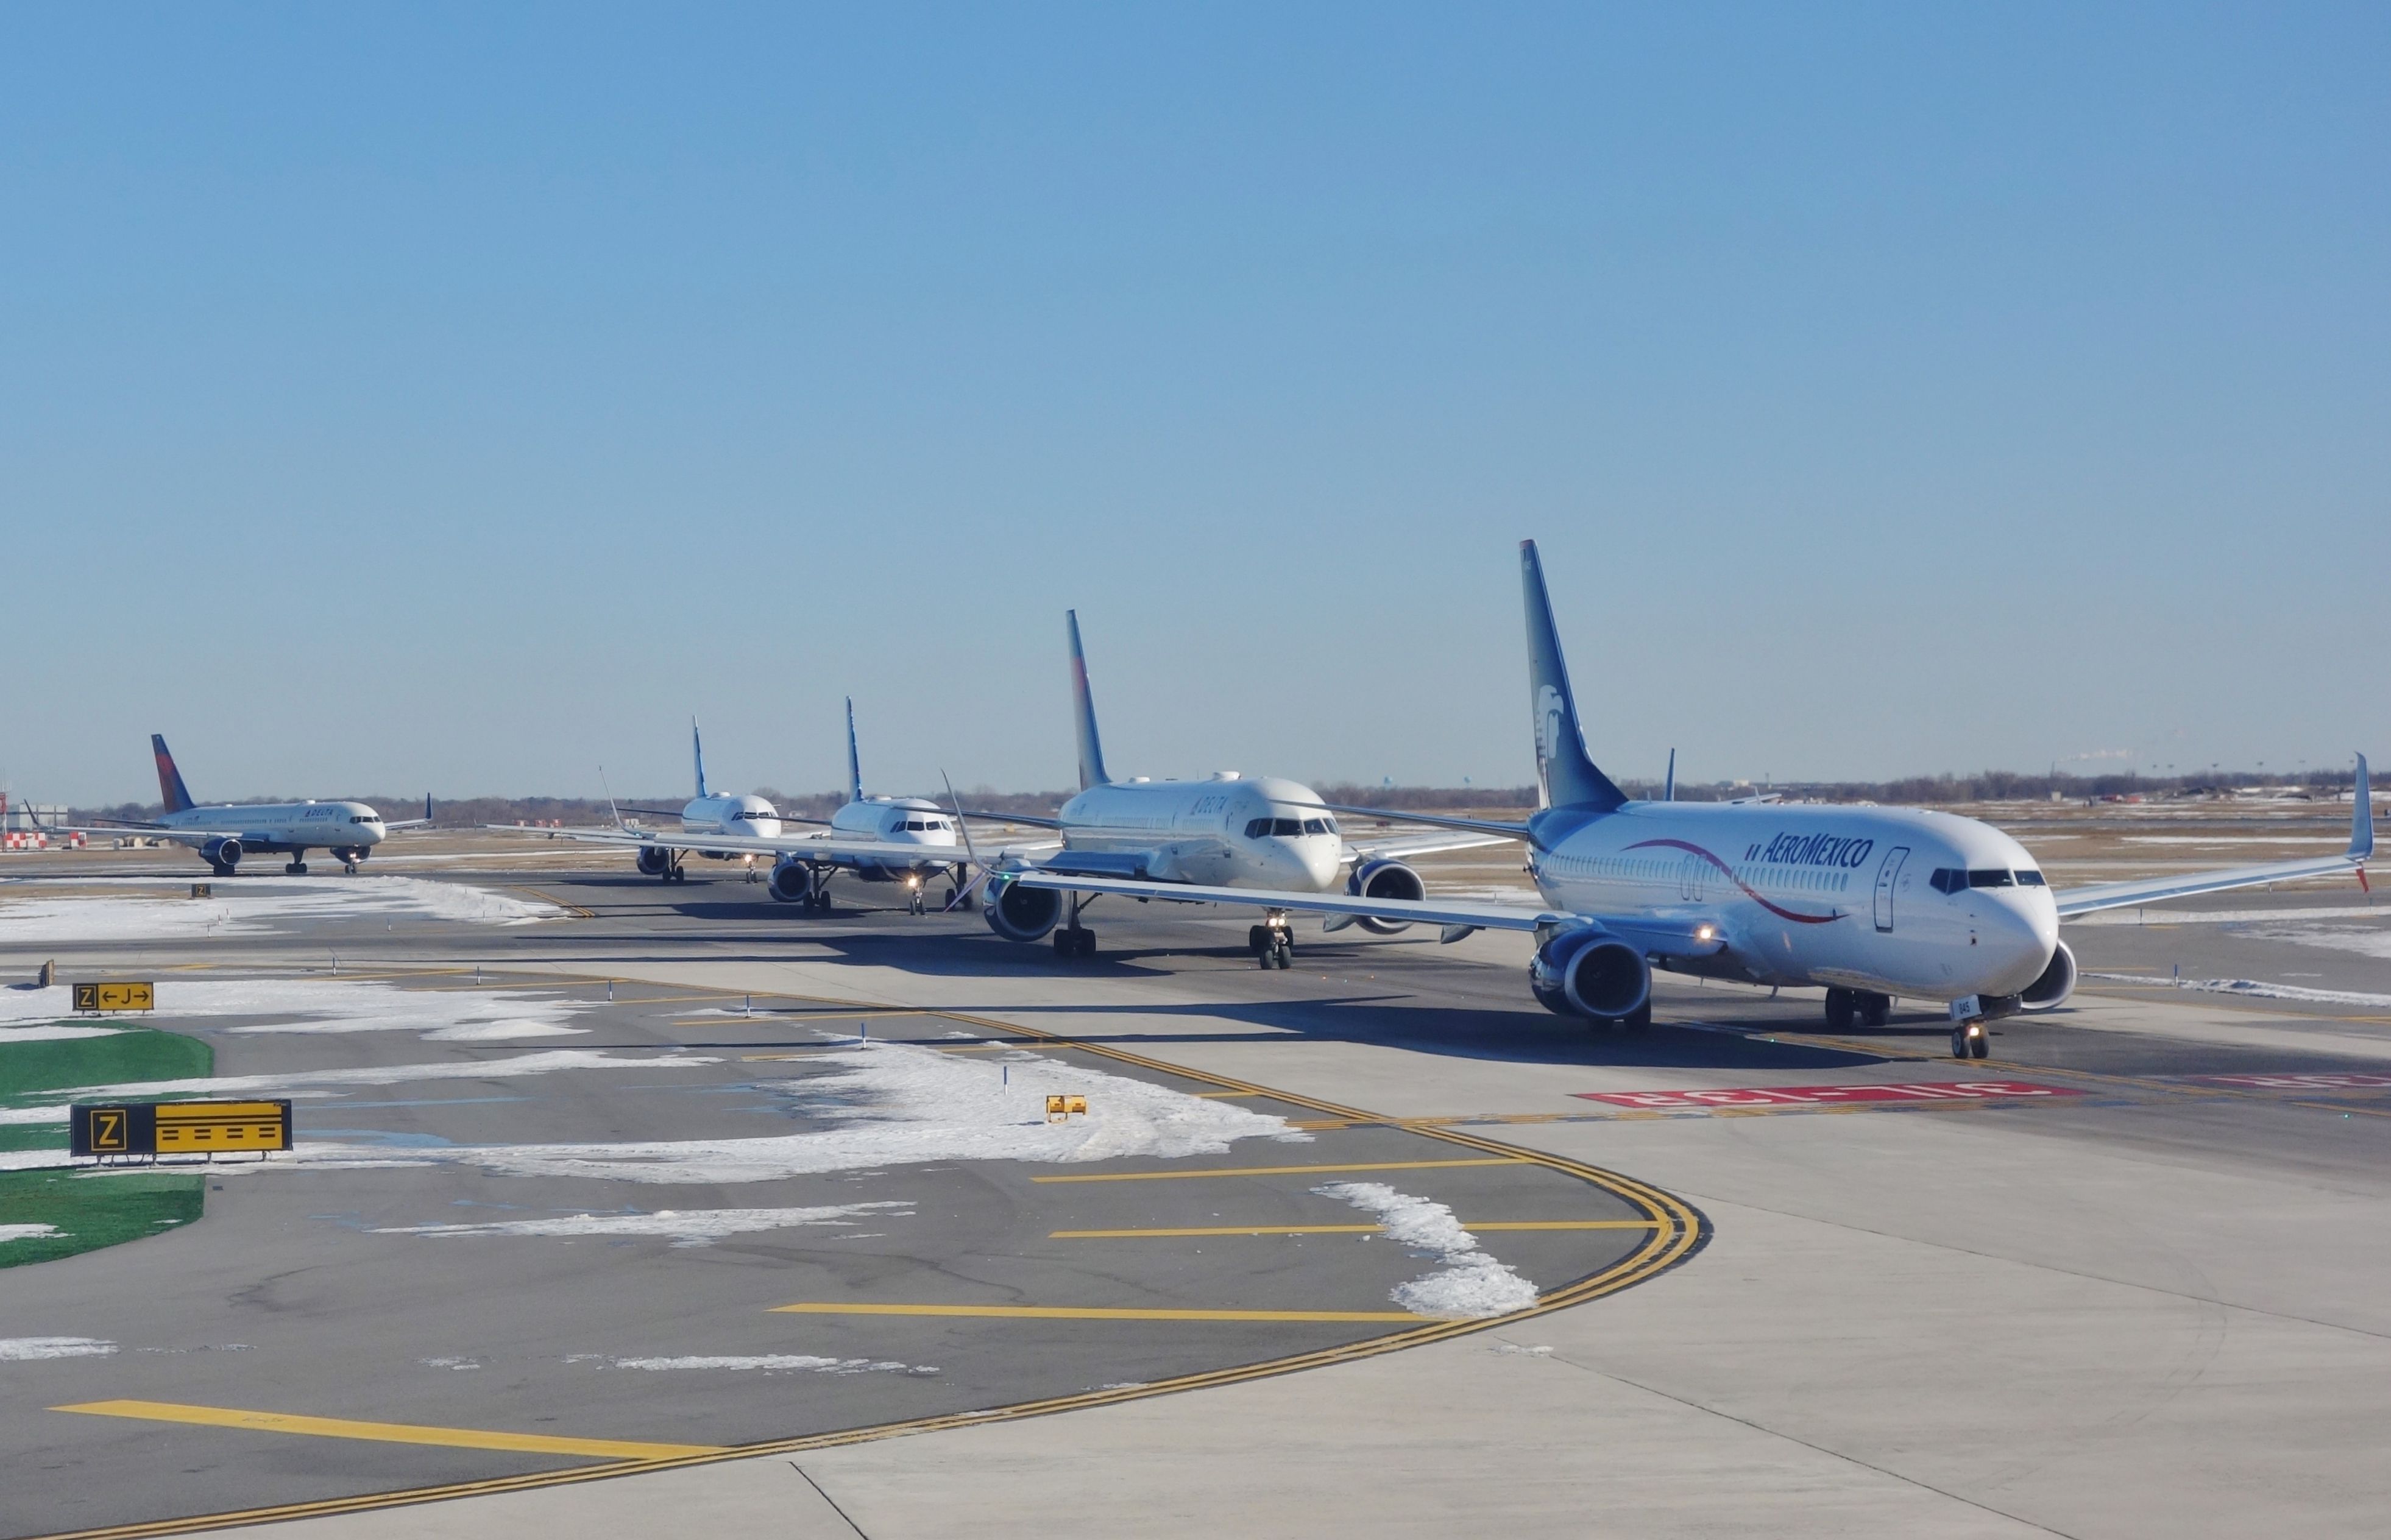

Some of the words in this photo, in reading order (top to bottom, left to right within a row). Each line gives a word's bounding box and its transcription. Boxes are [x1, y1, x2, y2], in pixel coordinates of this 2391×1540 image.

[80, 989, 92, 1005] Z
[121, 988, 130, 1004] J
[99, 1116, 118, 1145] Z
